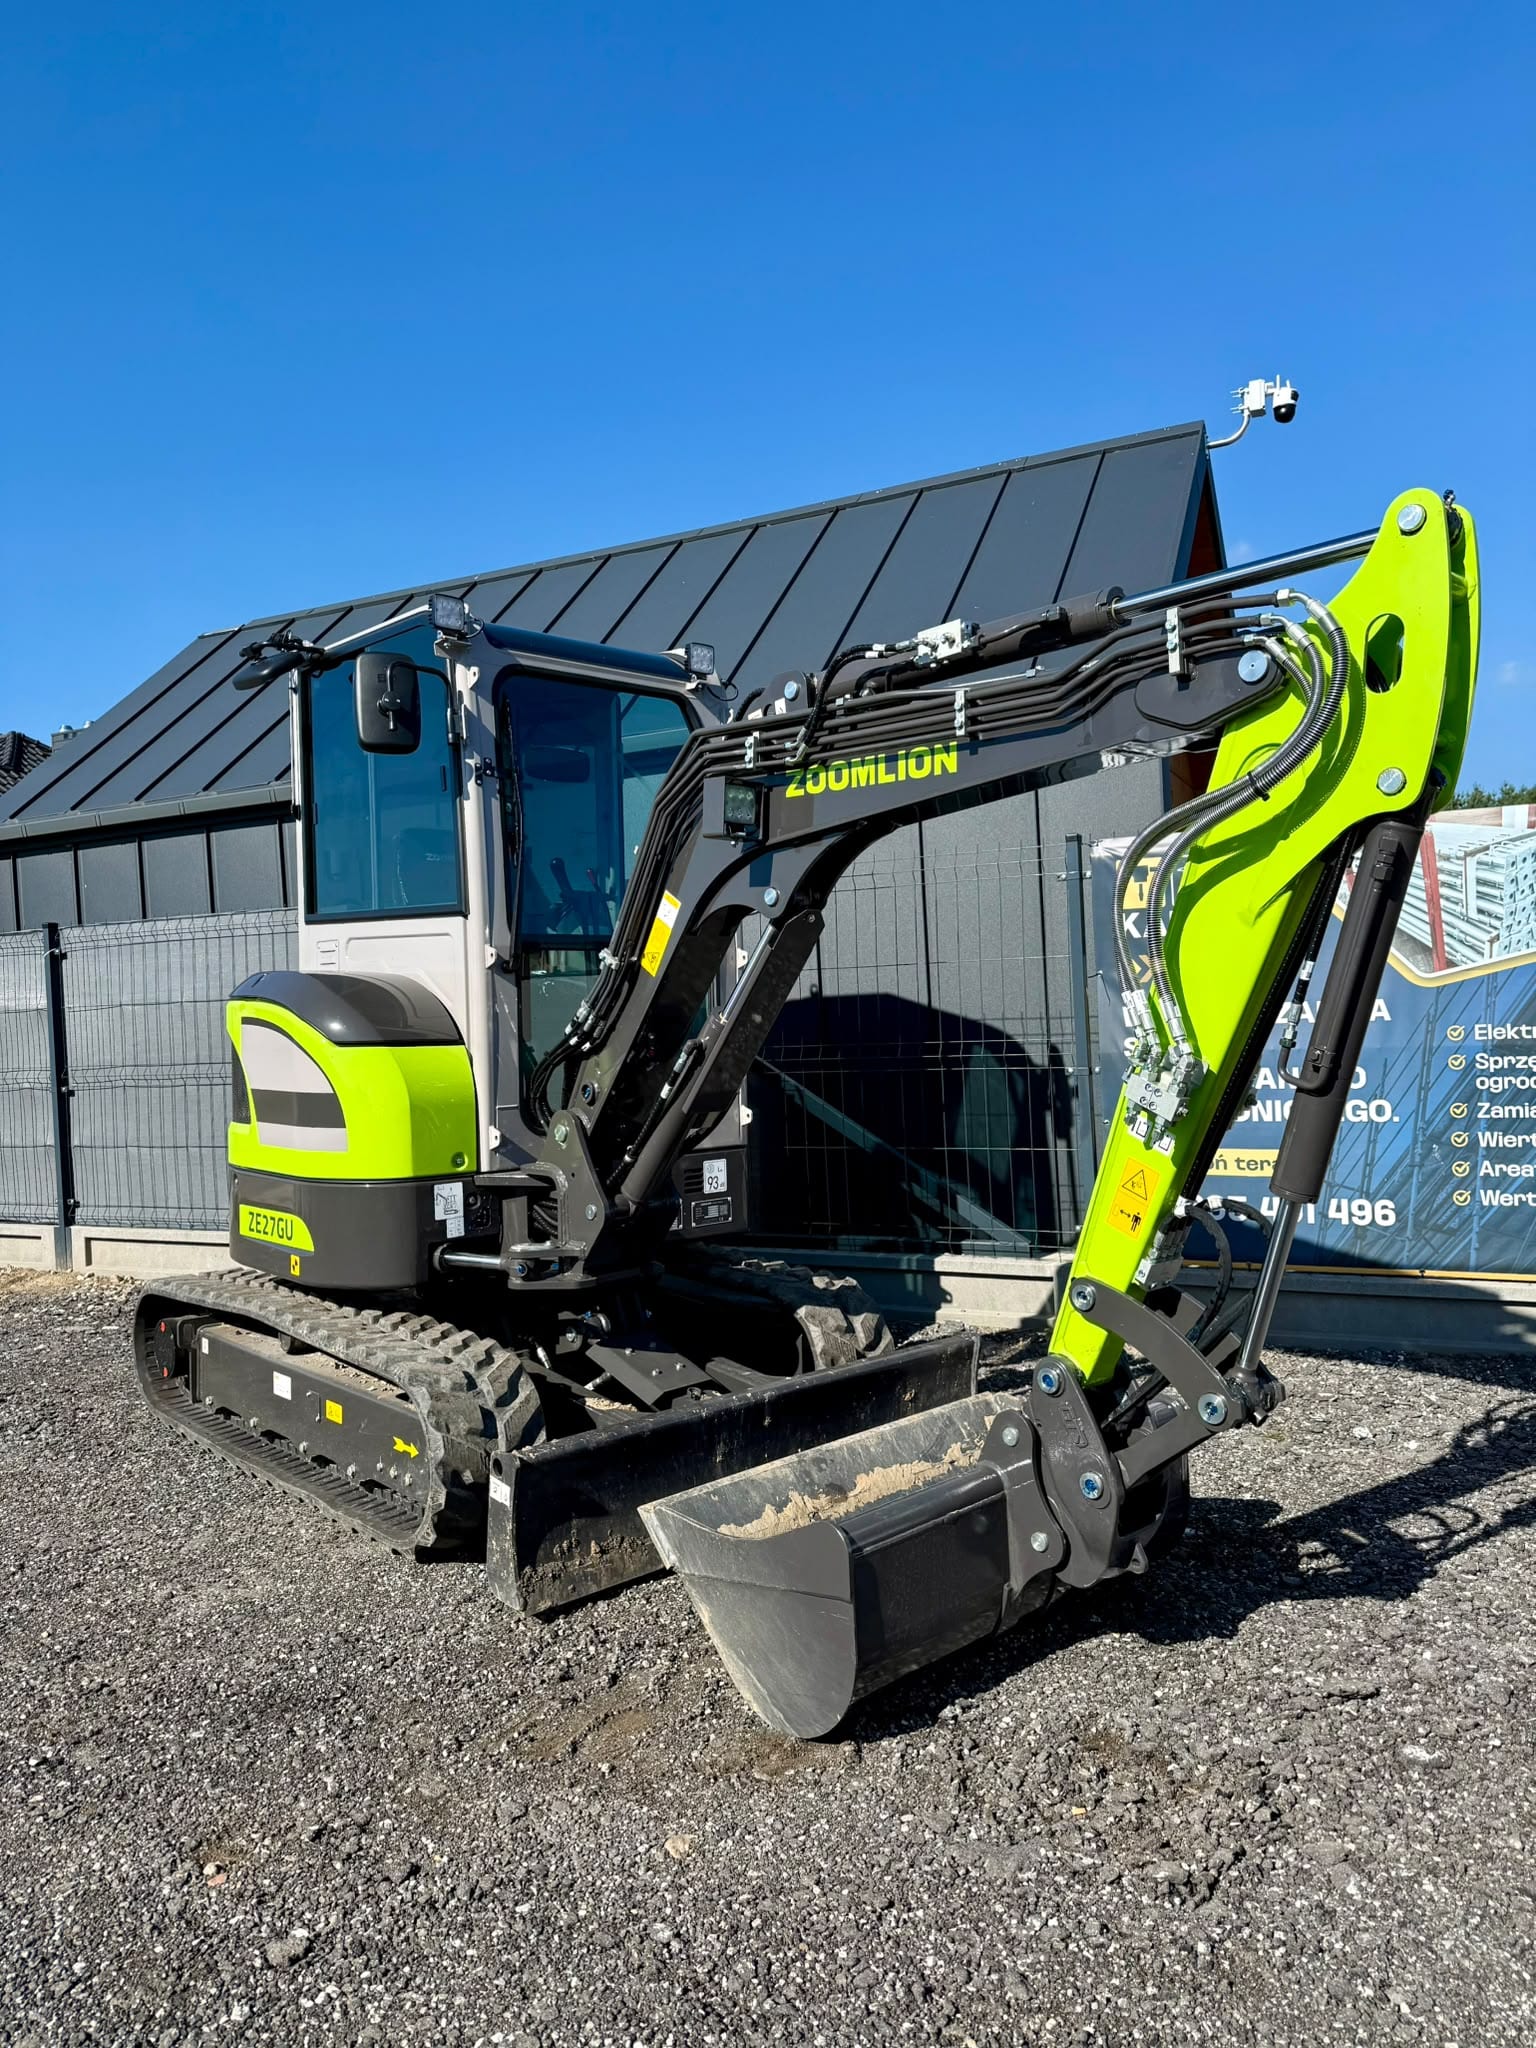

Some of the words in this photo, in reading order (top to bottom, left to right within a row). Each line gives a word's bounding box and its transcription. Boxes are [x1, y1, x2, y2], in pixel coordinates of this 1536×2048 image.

[785, 741, 958, 798] ZOOMLION
[707, 1176, 719, 1191] 93
[248, 1211, 293, 1241] ZE27GU
[1328, 1198, 1396, 1227] 496
